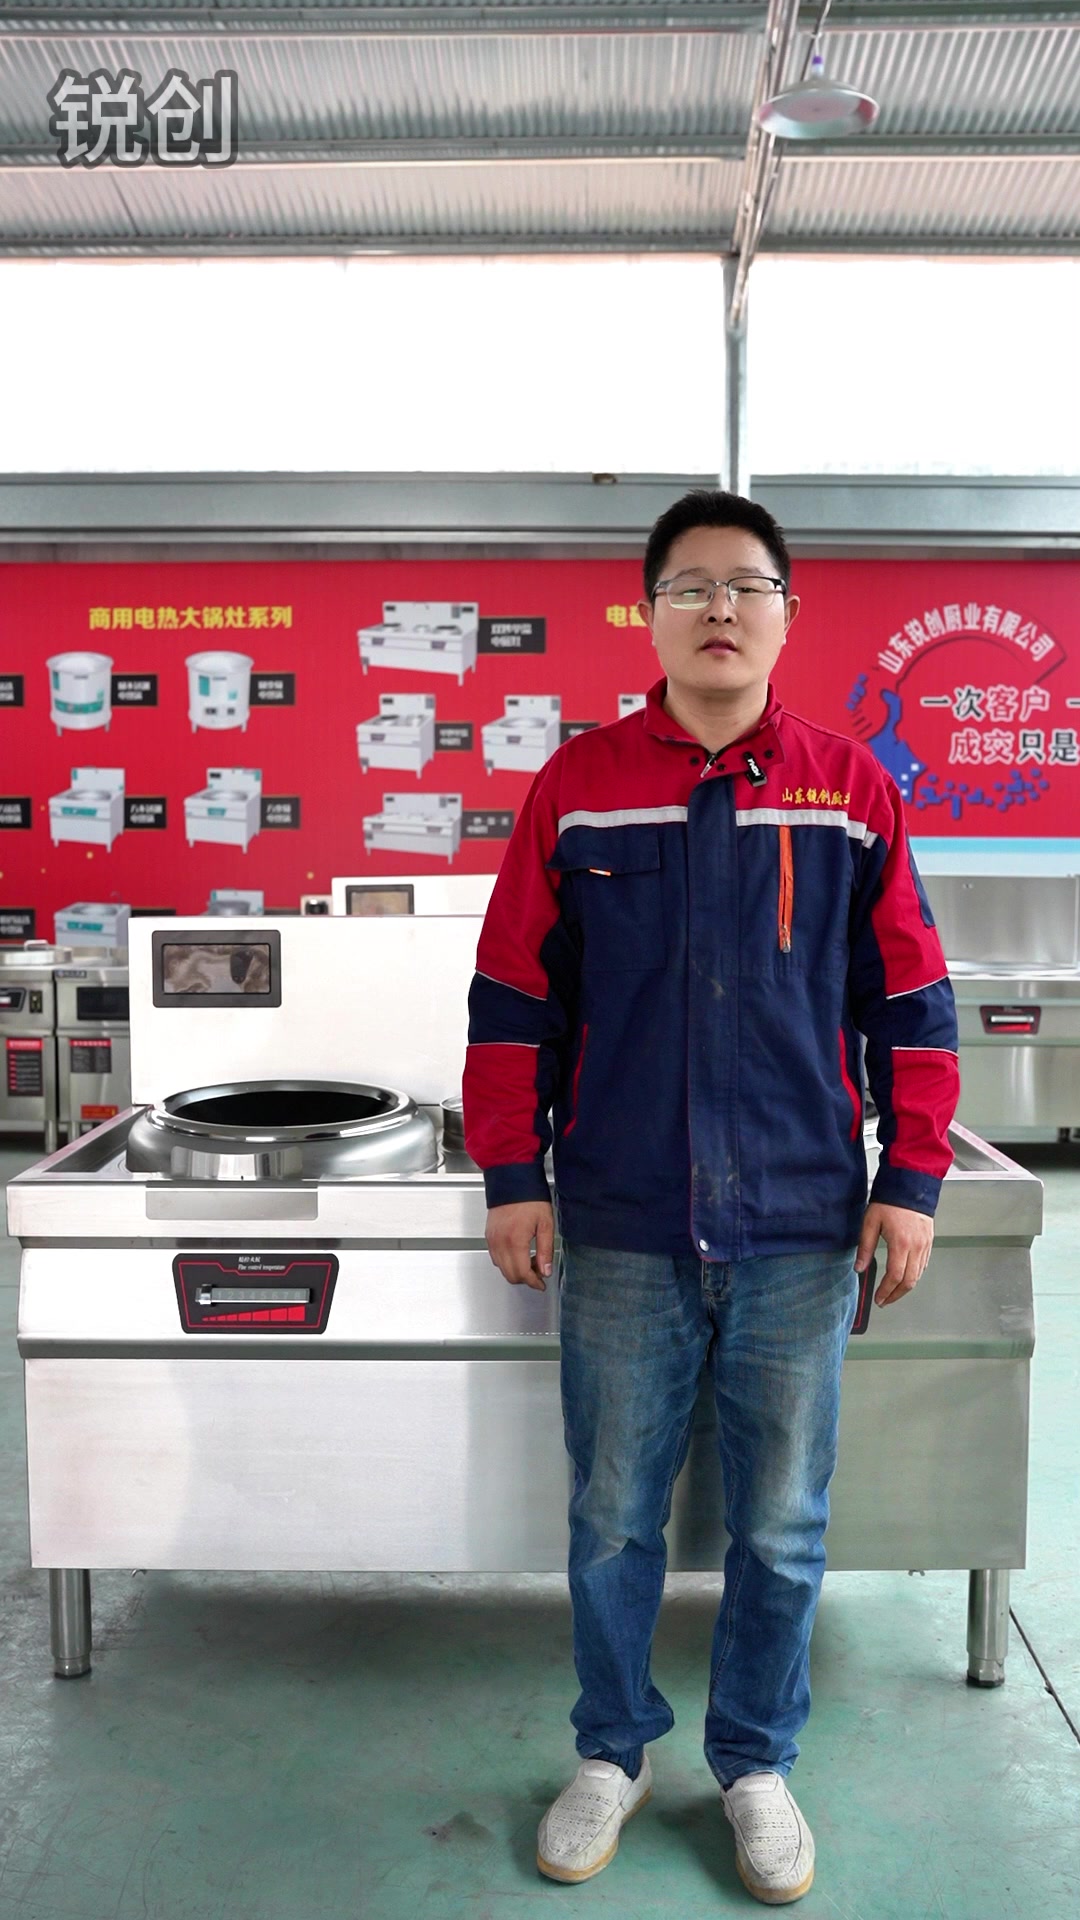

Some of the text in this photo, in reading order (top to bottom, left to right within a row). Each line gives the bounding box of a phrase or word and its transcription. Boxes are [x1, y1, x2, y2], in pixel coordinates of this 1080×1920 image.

[89, 606, 293, 630] 商用电热大锅灶系列
[877, 602, 1055, 674] 山东锐创厨业有限公司
[948, 728, 1080, 766] 成交只是
